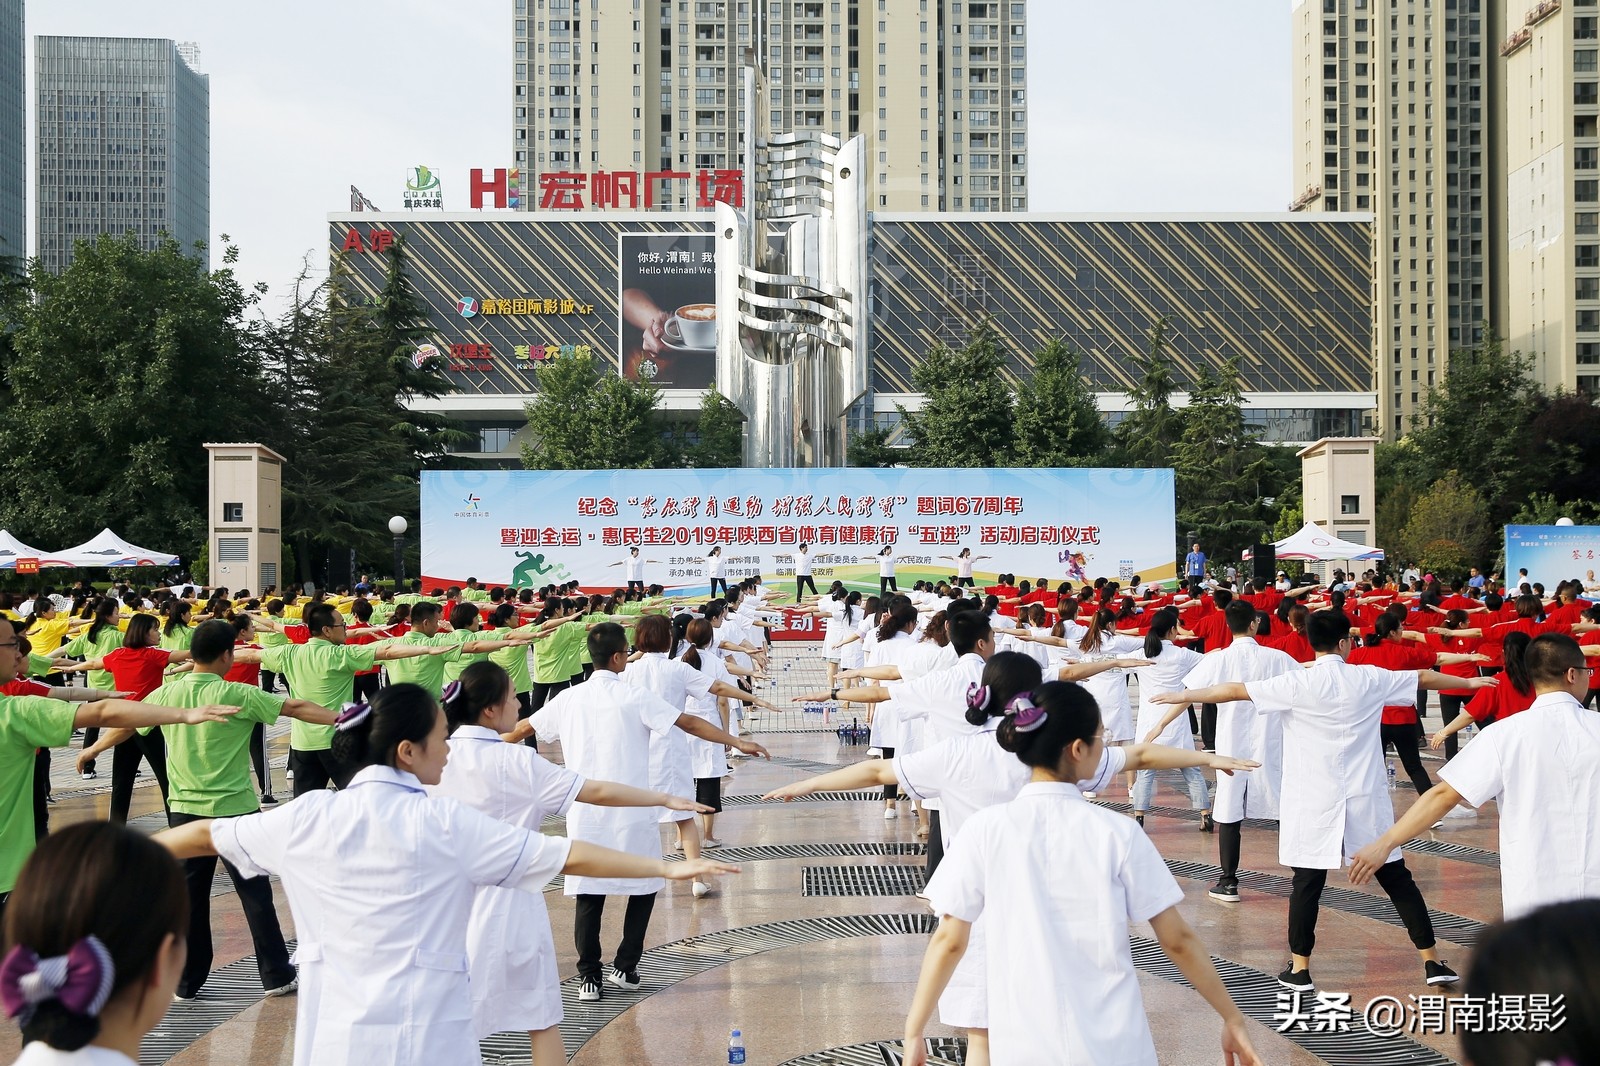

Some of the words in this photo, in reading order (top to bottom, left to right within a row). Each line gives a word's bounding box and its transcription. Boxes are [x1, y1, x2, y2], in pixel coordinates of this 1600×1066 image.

[539, 169, 743, 209] 宏帆广场
[639, 266, 661, 274] Hello
[664, 266, 697, 274] Weinan!
[699, 266, 712, 274] We
[481, 298, 575, 315] 嘉裕国际影城
[579, 304, 594, 315] 4F
